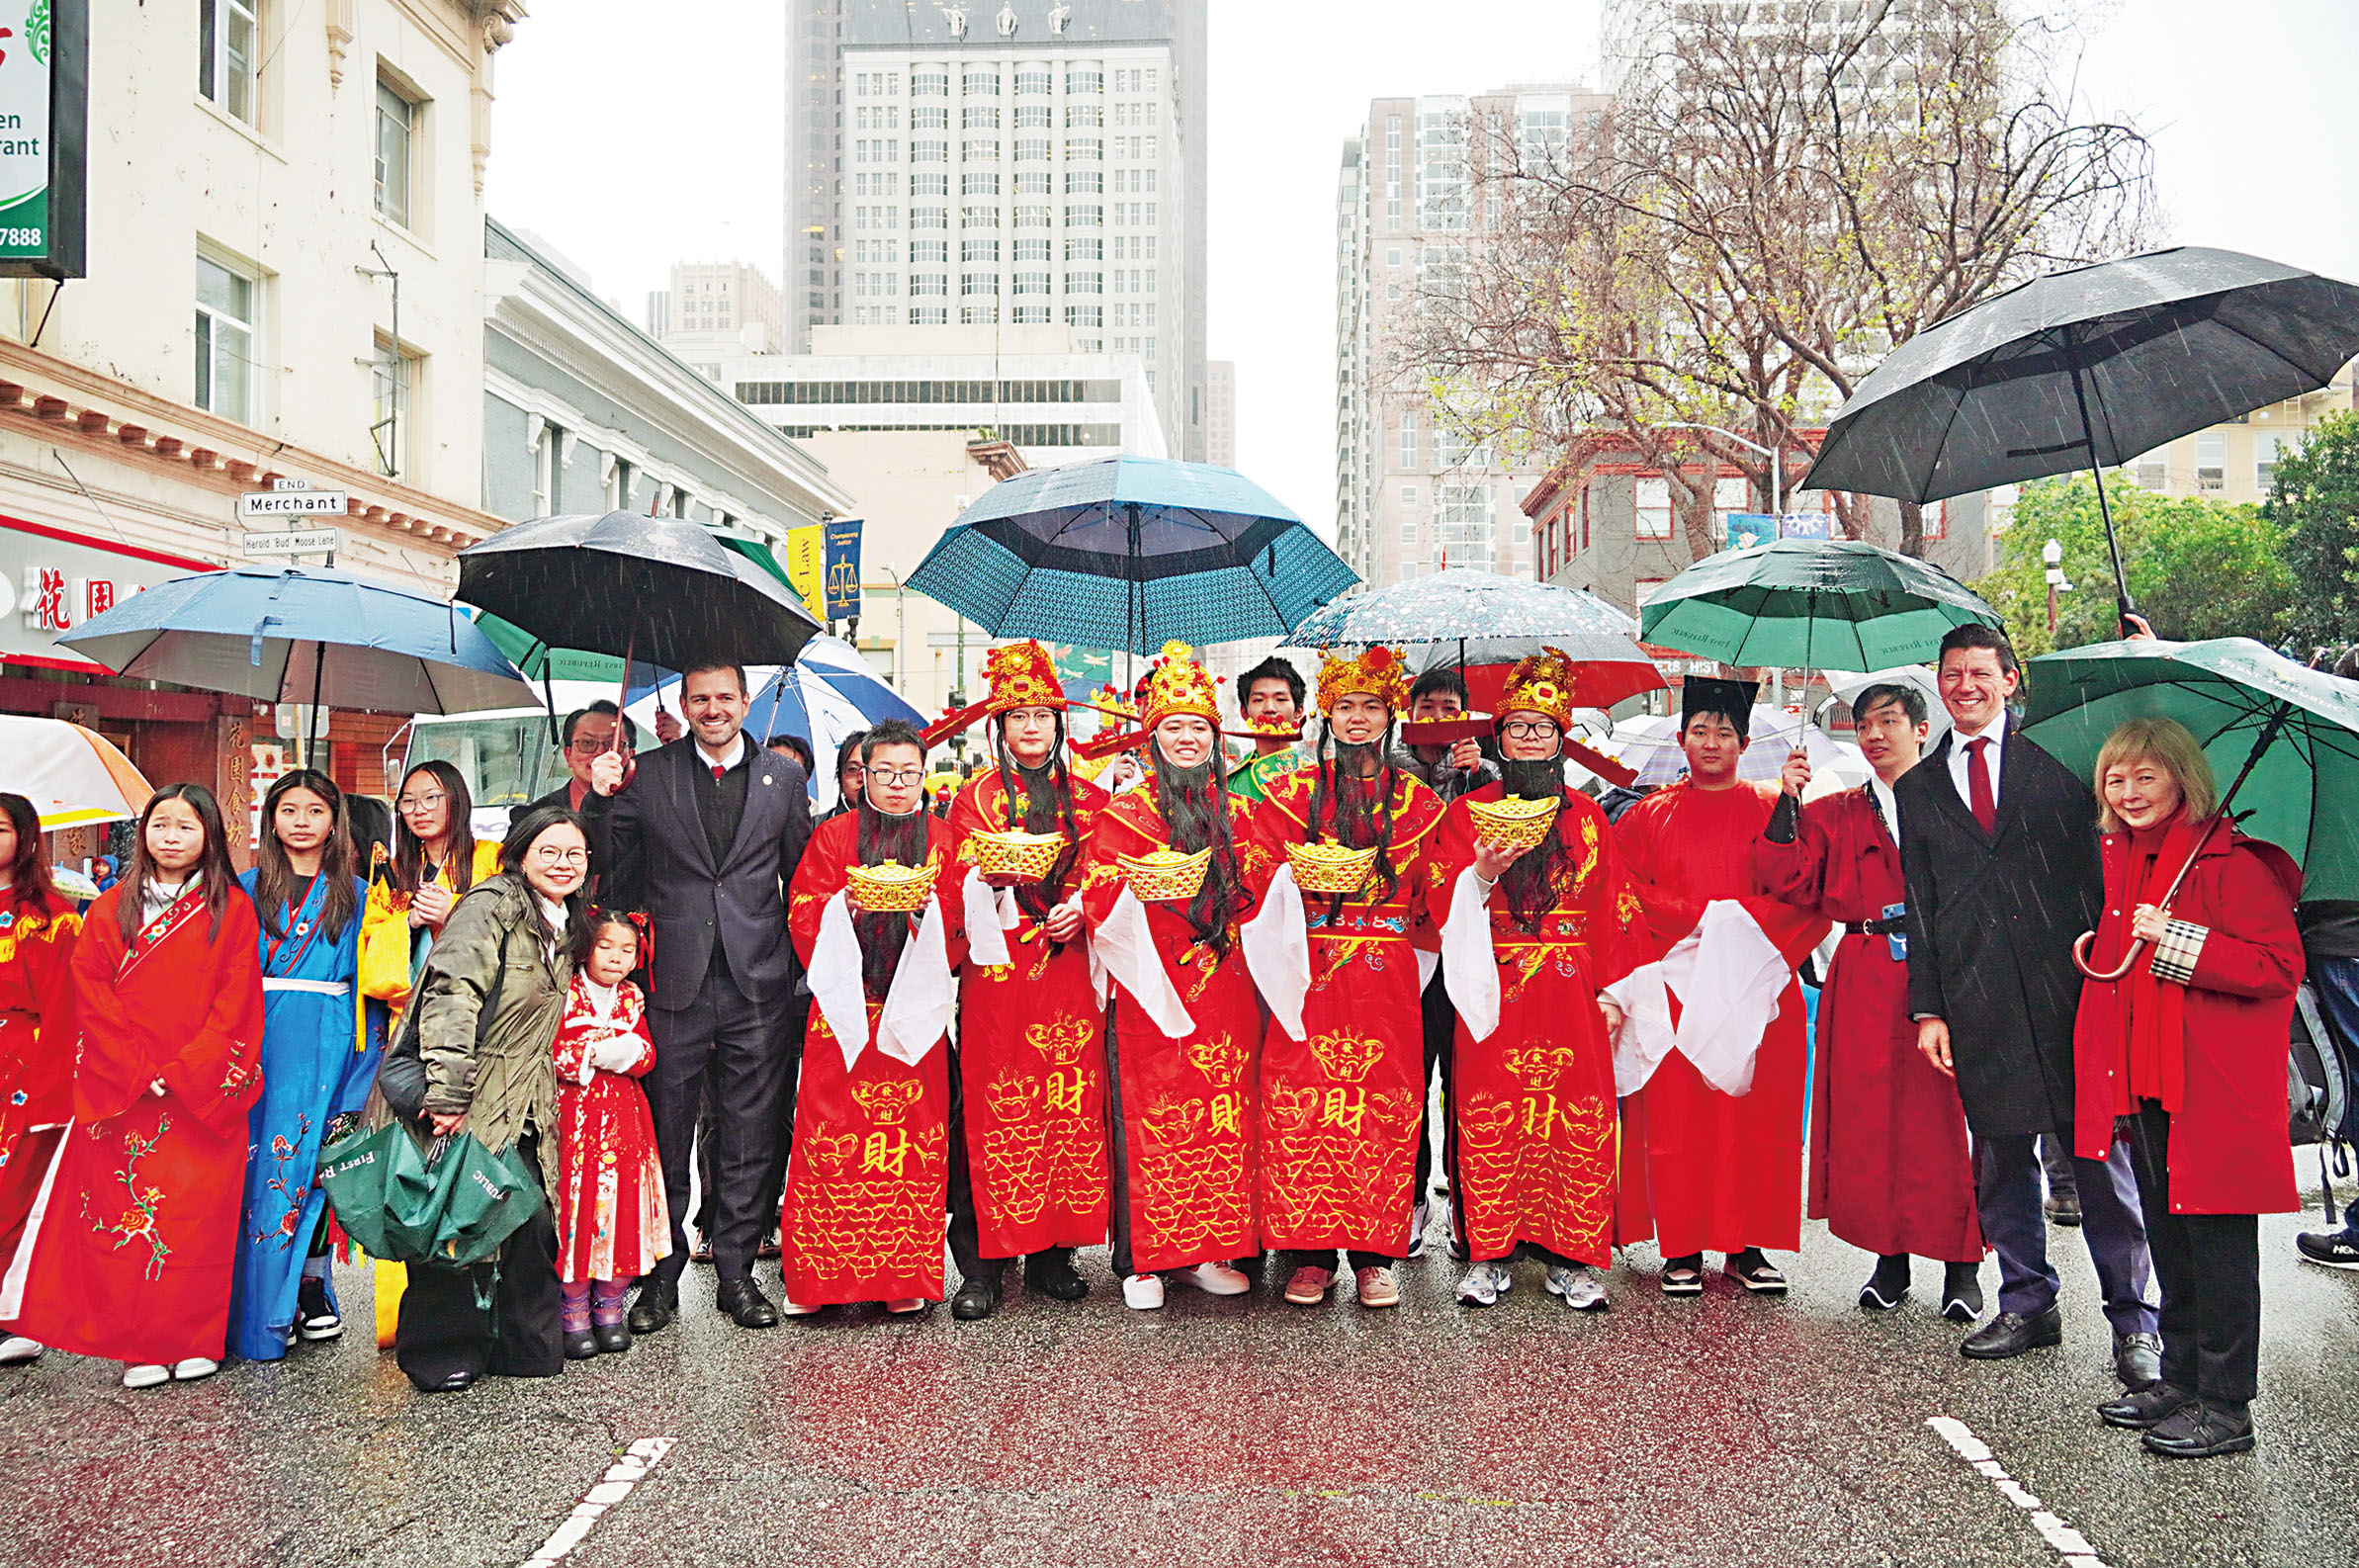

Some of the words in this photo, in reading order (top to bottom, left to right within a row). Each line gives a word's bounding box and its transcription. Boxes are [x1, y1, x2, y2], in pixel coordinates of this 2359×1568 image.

[251, 496, 336, 512] Merchant
[279, 479, 306, 489] END
[246, 538, 270, 549] Harold
[296, 536, 315, 547] Moose
[318, 535, 334, 546] Lane
[37, 567, 147, 630] 花園
[1041, 1066, 1089, 1116] 財
[1317, 1086, 1367, 1138] 財
[857, 1127, 913, 1177] 財
